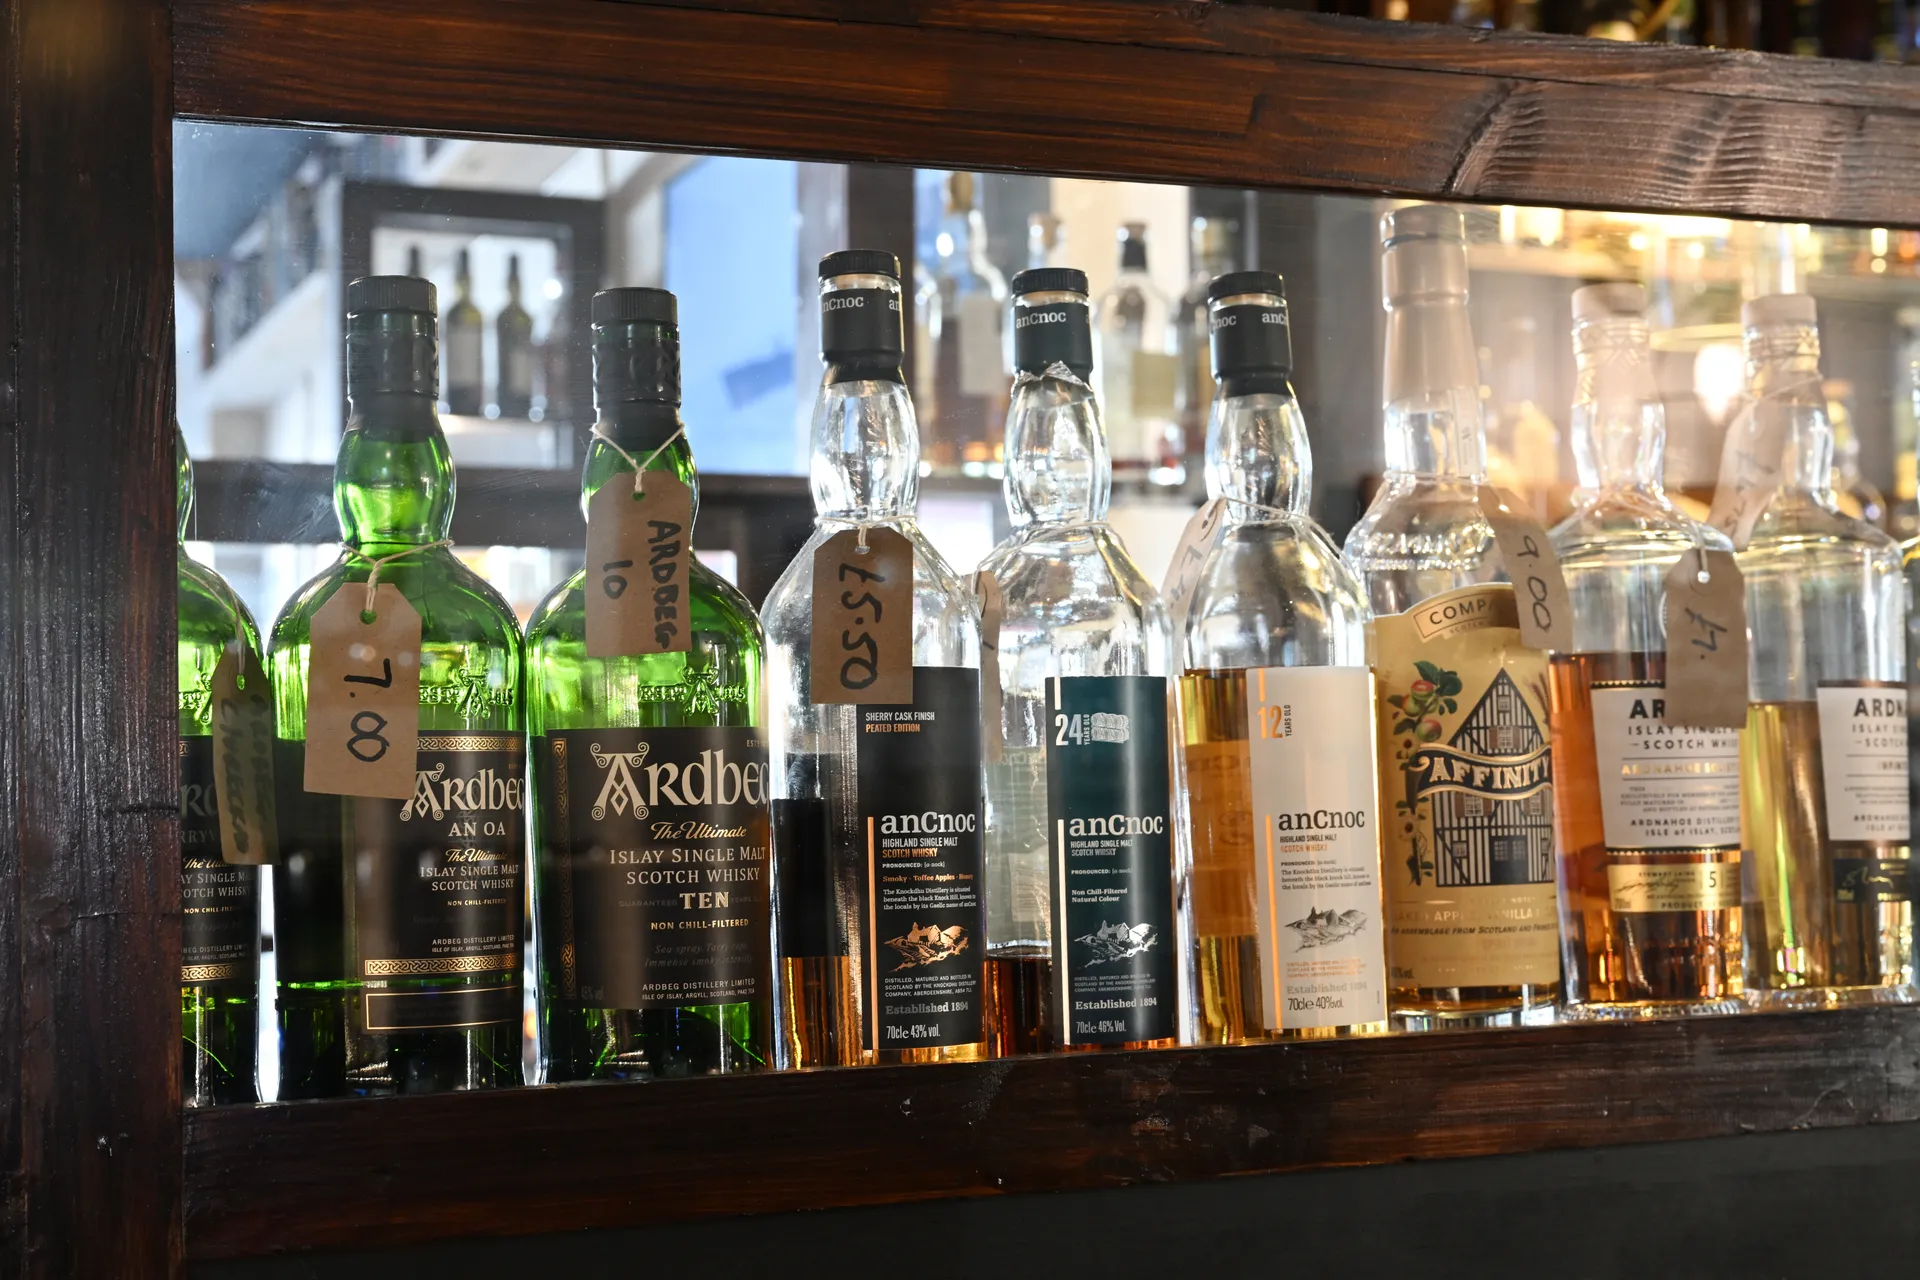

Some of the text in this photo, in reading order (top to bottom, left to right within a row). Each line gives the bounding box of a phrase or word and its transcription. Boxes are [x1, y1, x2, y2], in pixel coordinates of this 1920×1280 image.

[1016, 312, 1067, 329] anCnoc
[602, 559, 633, 600] 10
[647, 520, 681, 649] ARDBEG
[1517, 535, 1551, 631] 9.00
[839, 562, 886, 690] £5.50
[343, 658, 392, 763] 7.00
[865, 711, 935, 721] SHERRY CASK FINISH
[865, 723, 920, 733] PEATED EDITION
[1256, 705, 1283, 739] 12
[1054, 713, 1084, 746] 24
[1628, 726, 1675, 736] ISLAY
[1644, 740, 1704, 750] SCOTCH
[1429, 755, 1549, 789] AFFINITY
[880, 811, 976, 834] anCnoc
[1069, 814, 1164, 837] anCnoc
[1278, 809, 1365, 831] anCnoc
[1631, 818, 1692, 826] ARDNAHOE
[448, 821, 506, 837] AN OA
[650, 821, 747, 840] The Ultimate
[882, 836, 958, 848] HIGHLAND SINGLE MALT
[1070, 840, 1099, 849] HIGHLAND
[1100, 840, 1119, 848] SINGLE
[1279, 833, 1337, 843] HIGHLAND SINGLE MALT
[445, 848, 467, 863] The
[610, 846, 766, 864] ISLAY SINGLE MALT
[882, 847, 938, 858] SCOTCH WHISKY
[1071, 848, 1116, 857] SCOTCH WHISKY
[197, 872, 236, 884] SINGLE
[420, 864, 519, 878] ISLAY SINGLE MALT
[626, 867, 760, 885] SCOTCH WHISKY
[913, 874, 934, 882] Toffee
[934, 874, 956, 882] Apples
[431, 879, 515, 891] SCOTCH WHISKY
[1708, 871, 1717, 888] 5
[181, 887, 214, 898] OTCH
[679, 891, 729, 909] TEN
[650, 919, 749, 931] NON CHILL-FILTERED
[1452, 926, 1475, 935] FROM
[1477, 925, 1517, 934] SCOTLAND
[432, 938, 461, 946] ARDBEG
[463, 936, 496, 944] DISTILLERY
[642, 977, 755, 991] ARDBEG DISTILLERY LIMITED
[709, 990, 736, 998] SCOTLAND,
[885, 1001, 969, 1015] Established 1894
[1075, 997, 1157, 1010] Established 1894
[910, 1024, 927, 1038] 43%
[927, 1023, 941, 1037] vol.
[1098, 1020, 1114, 1033] 46%
[1114, 1019, 1127, 1032] Vol.
